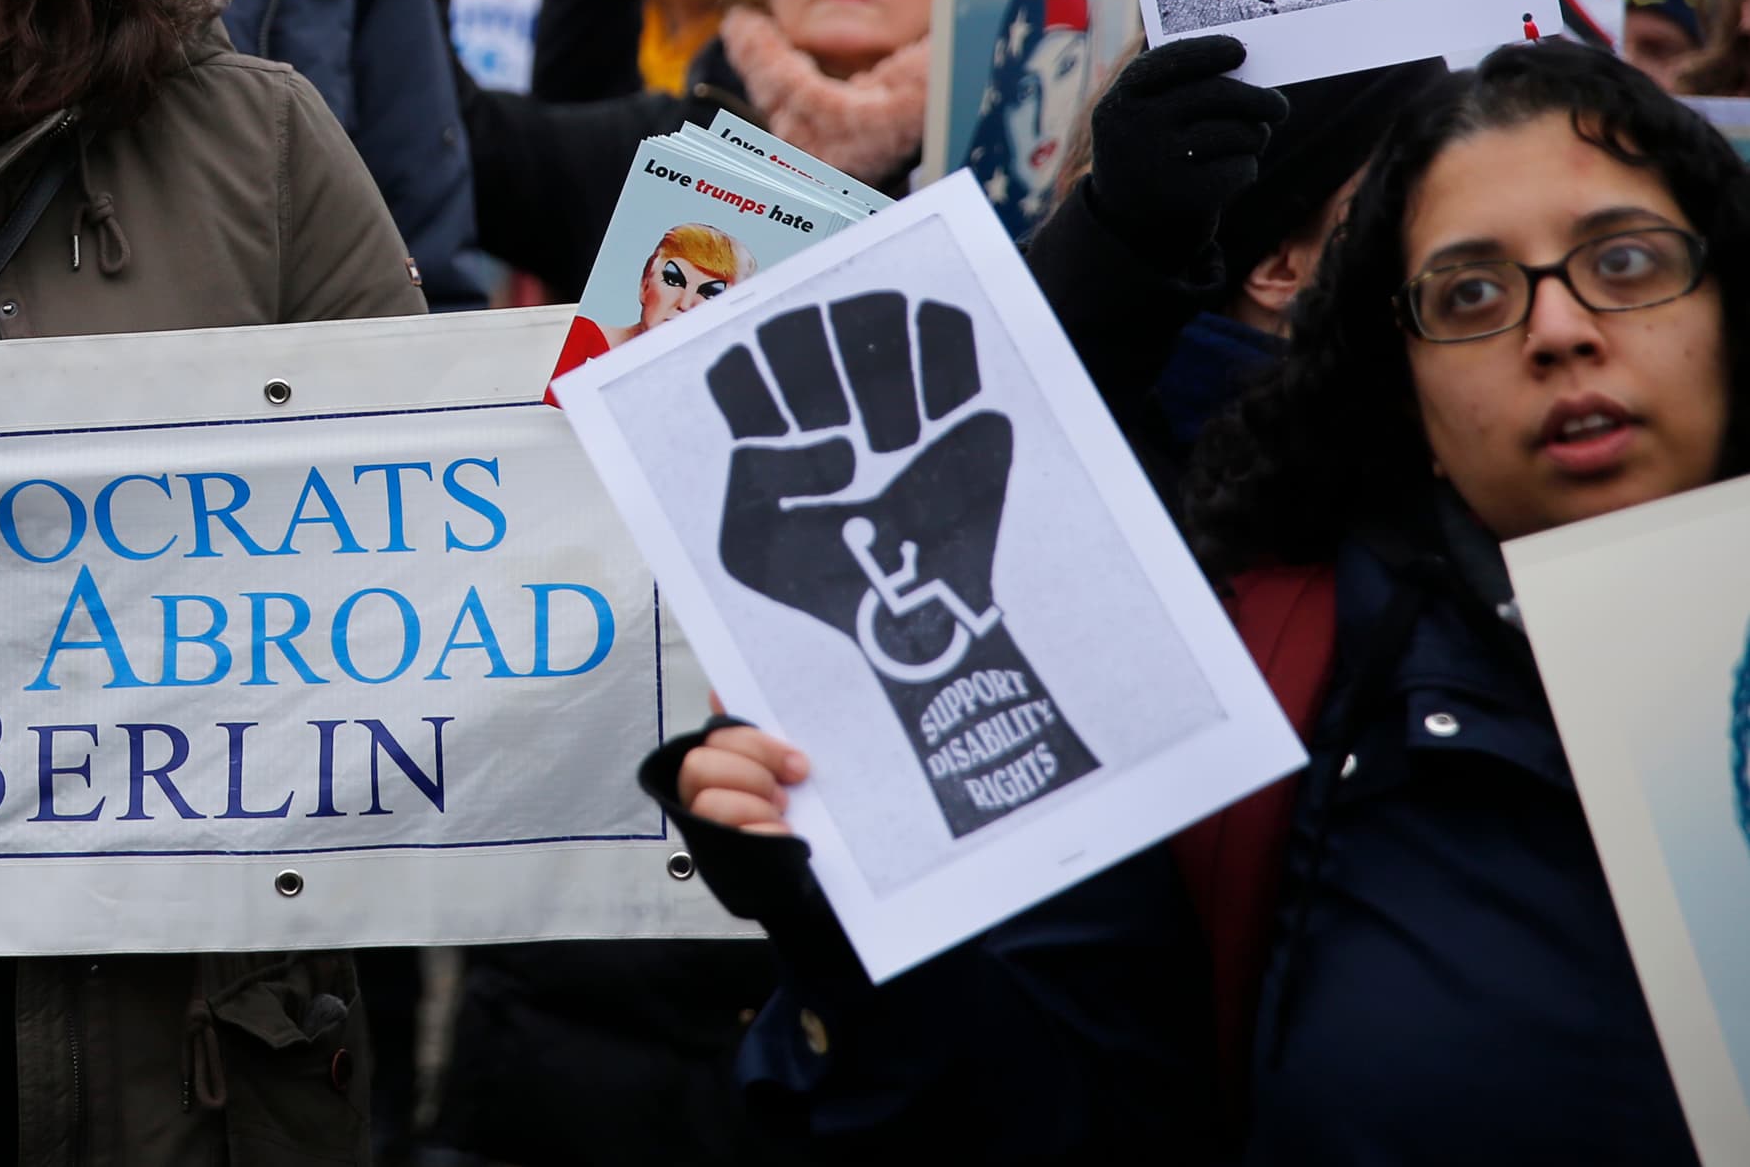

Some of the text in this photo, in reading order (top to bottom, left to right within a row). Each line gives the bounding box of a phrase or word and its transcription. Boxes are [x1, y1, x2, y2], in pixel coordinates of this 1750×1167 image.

[643, 158, 815, 233] Love trumps hate
[23, 564, 617, 692] ABROAD
[919, 668, 1030, 746] SUPPORT
[926, 698, 1054, 778] DISABILITY
[963, 741, 1059, 811] RIGHTS
